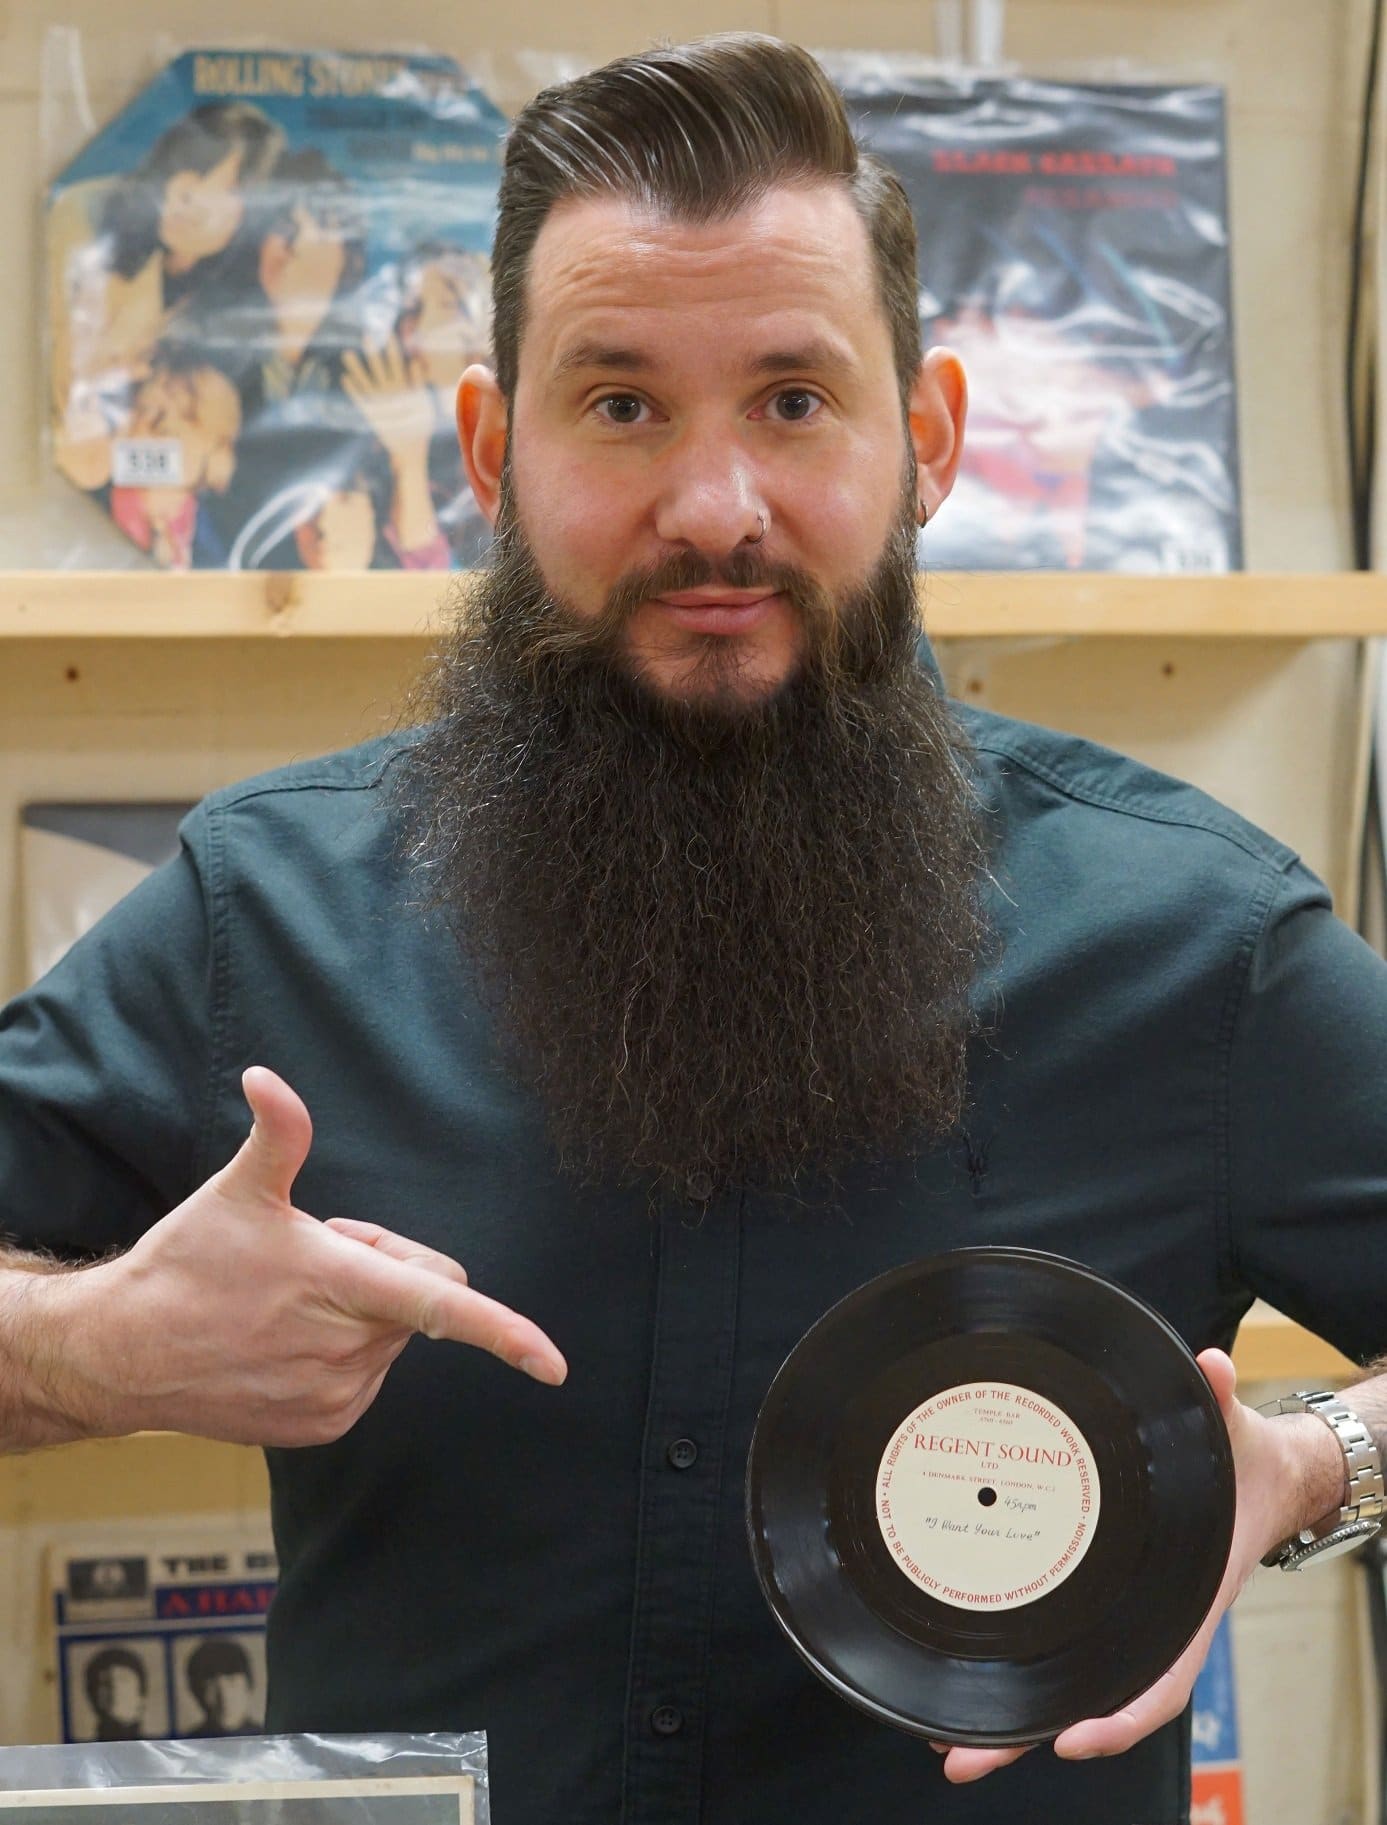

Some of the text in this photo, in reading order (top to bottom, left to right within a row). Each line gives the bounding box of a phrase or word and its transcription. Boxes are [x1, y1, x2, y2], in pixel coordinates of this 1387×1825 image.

[882, 1390, 1090, 1512] ALL RIGHTS OF THE OWNER OF THE RECORDED WORK RESERVED
[914, 1433, 1072, 1467] REGENT SOUND
[928, 1472, 965, 1482] DENMARK
[981, 1462, 999, 1470] LTD
[941, 1520, 969, 1533] Want
[975, 1525, 1000, 1537] Your
[882, 1499, 1087, 1603] NOT TO BE PUBLICLY PERFORMED WITHOUT PERMISSION
